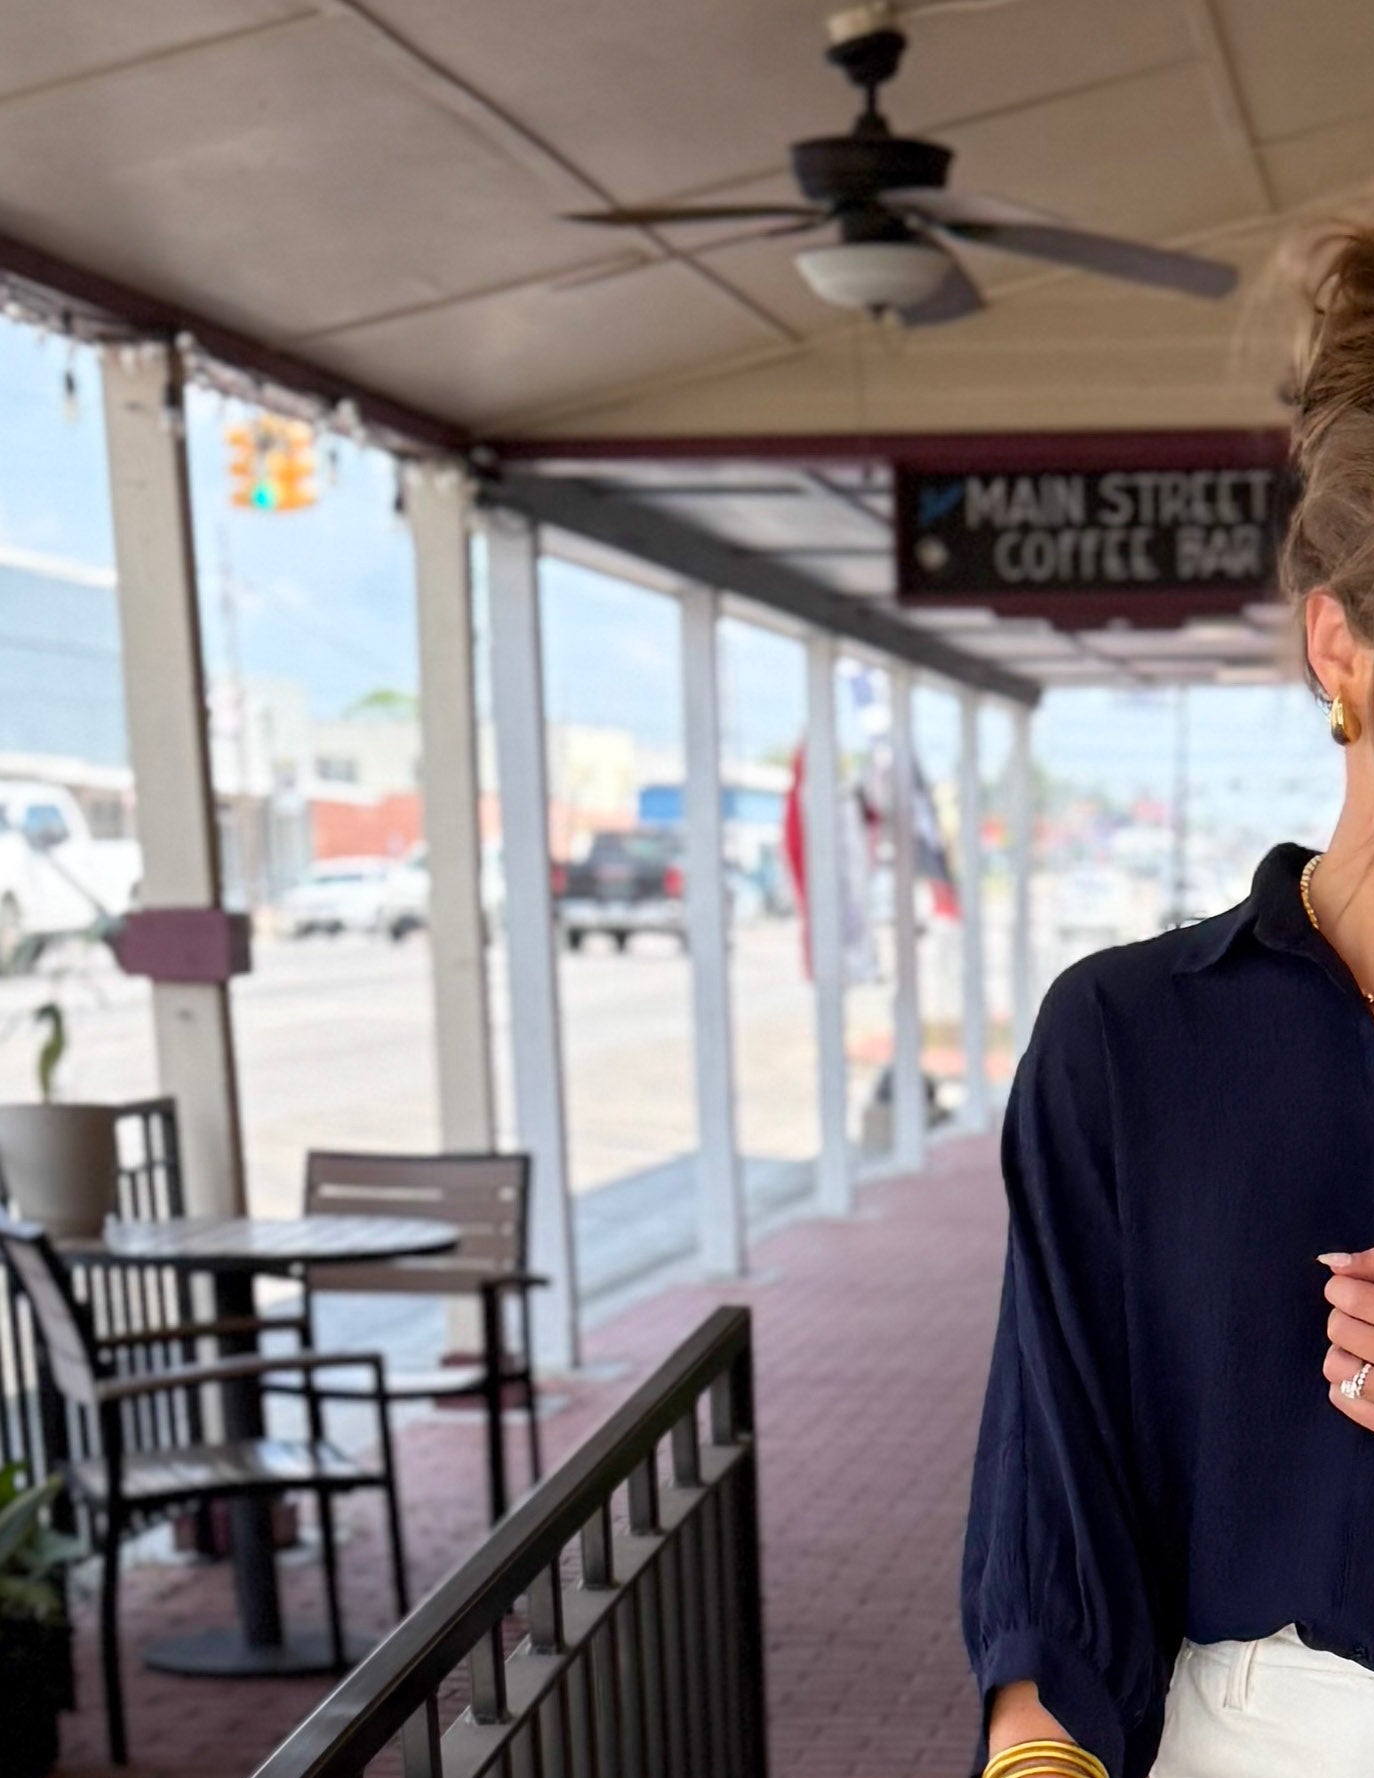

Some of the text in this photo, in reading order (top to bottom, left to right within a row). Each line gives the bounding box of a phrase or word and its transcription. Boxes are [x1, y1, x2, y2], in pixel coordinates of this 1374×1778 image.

[965, 470, 1271, 529] MAIN STREET
[995, 524, 1261, 583] COFFEE BAR
